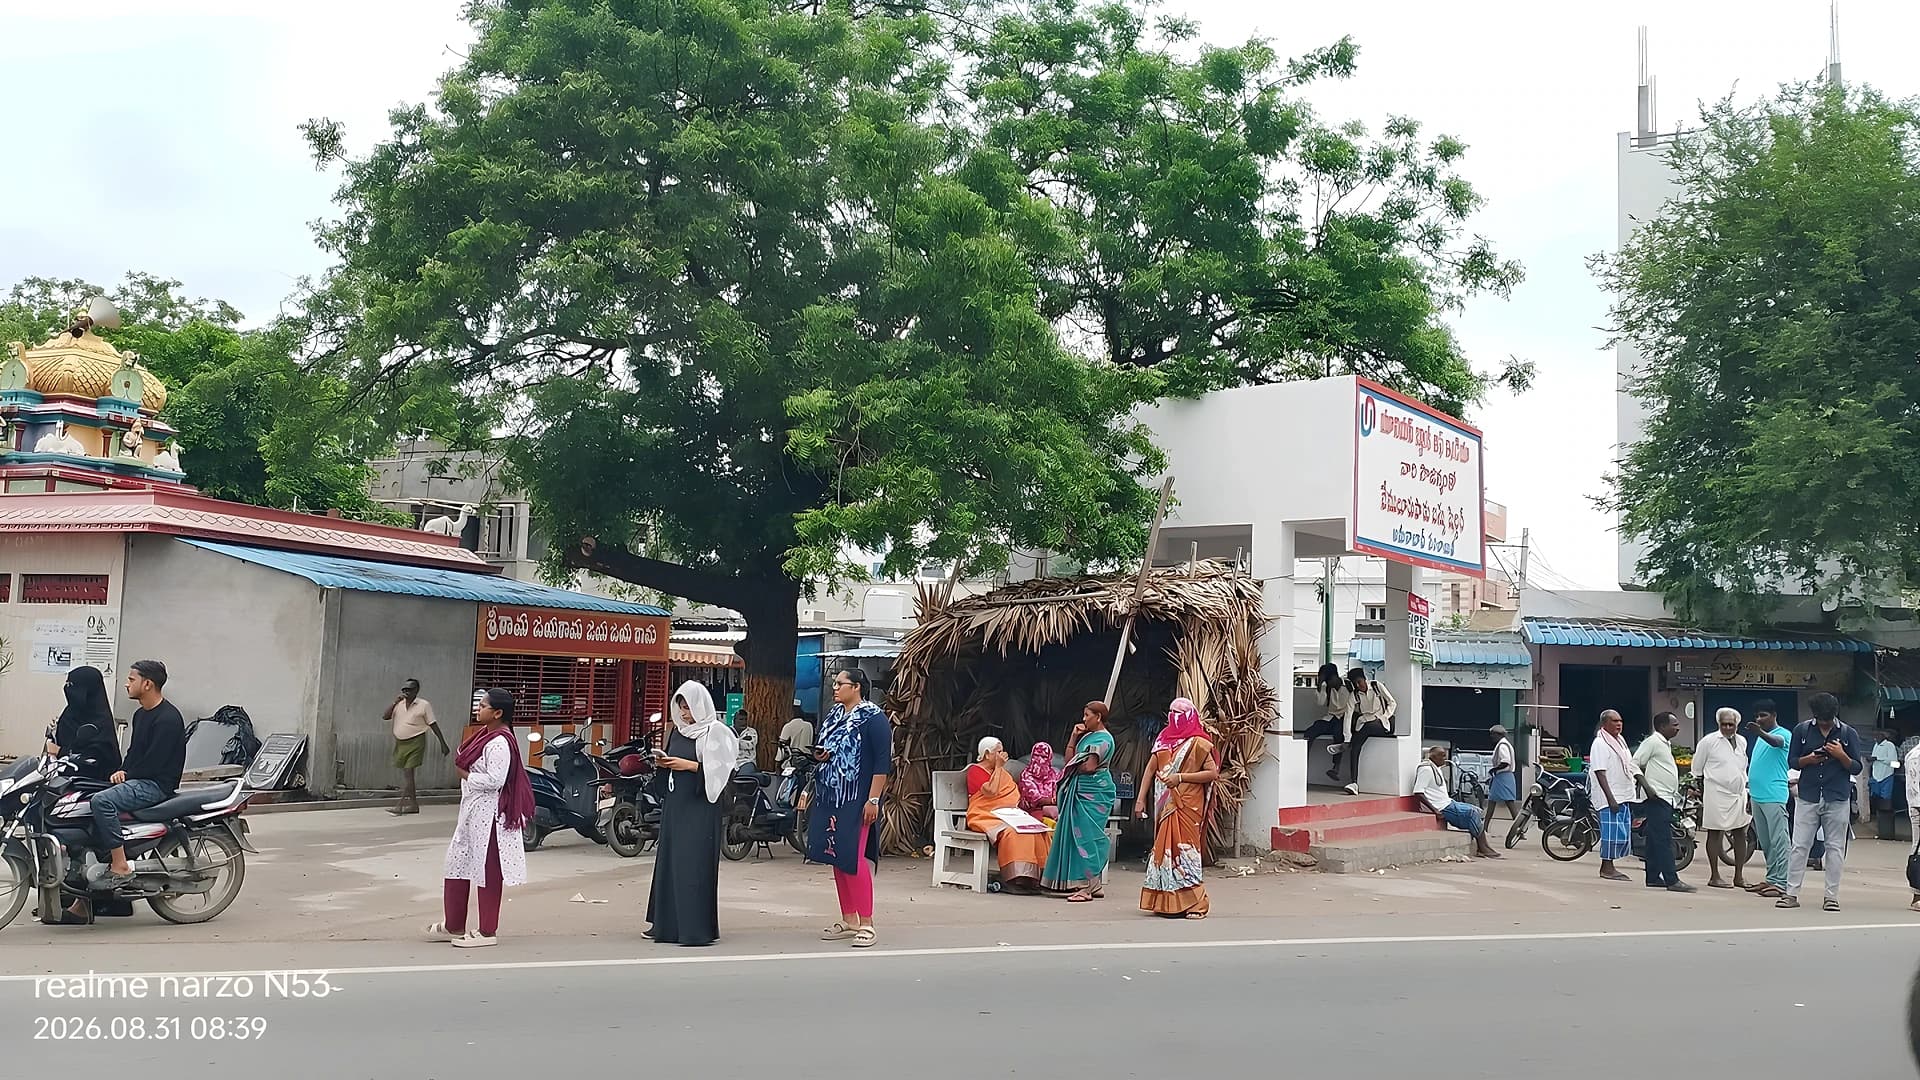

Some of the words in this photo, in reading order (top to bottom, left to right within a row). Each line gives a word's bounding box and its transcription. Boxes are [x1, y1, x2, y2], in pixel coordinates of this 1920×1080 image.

[1400, 461, 1417, 479] వారి
[486, 605, 529, 641] శ్రీరామ
[634, 624, 657, 645] రామ
